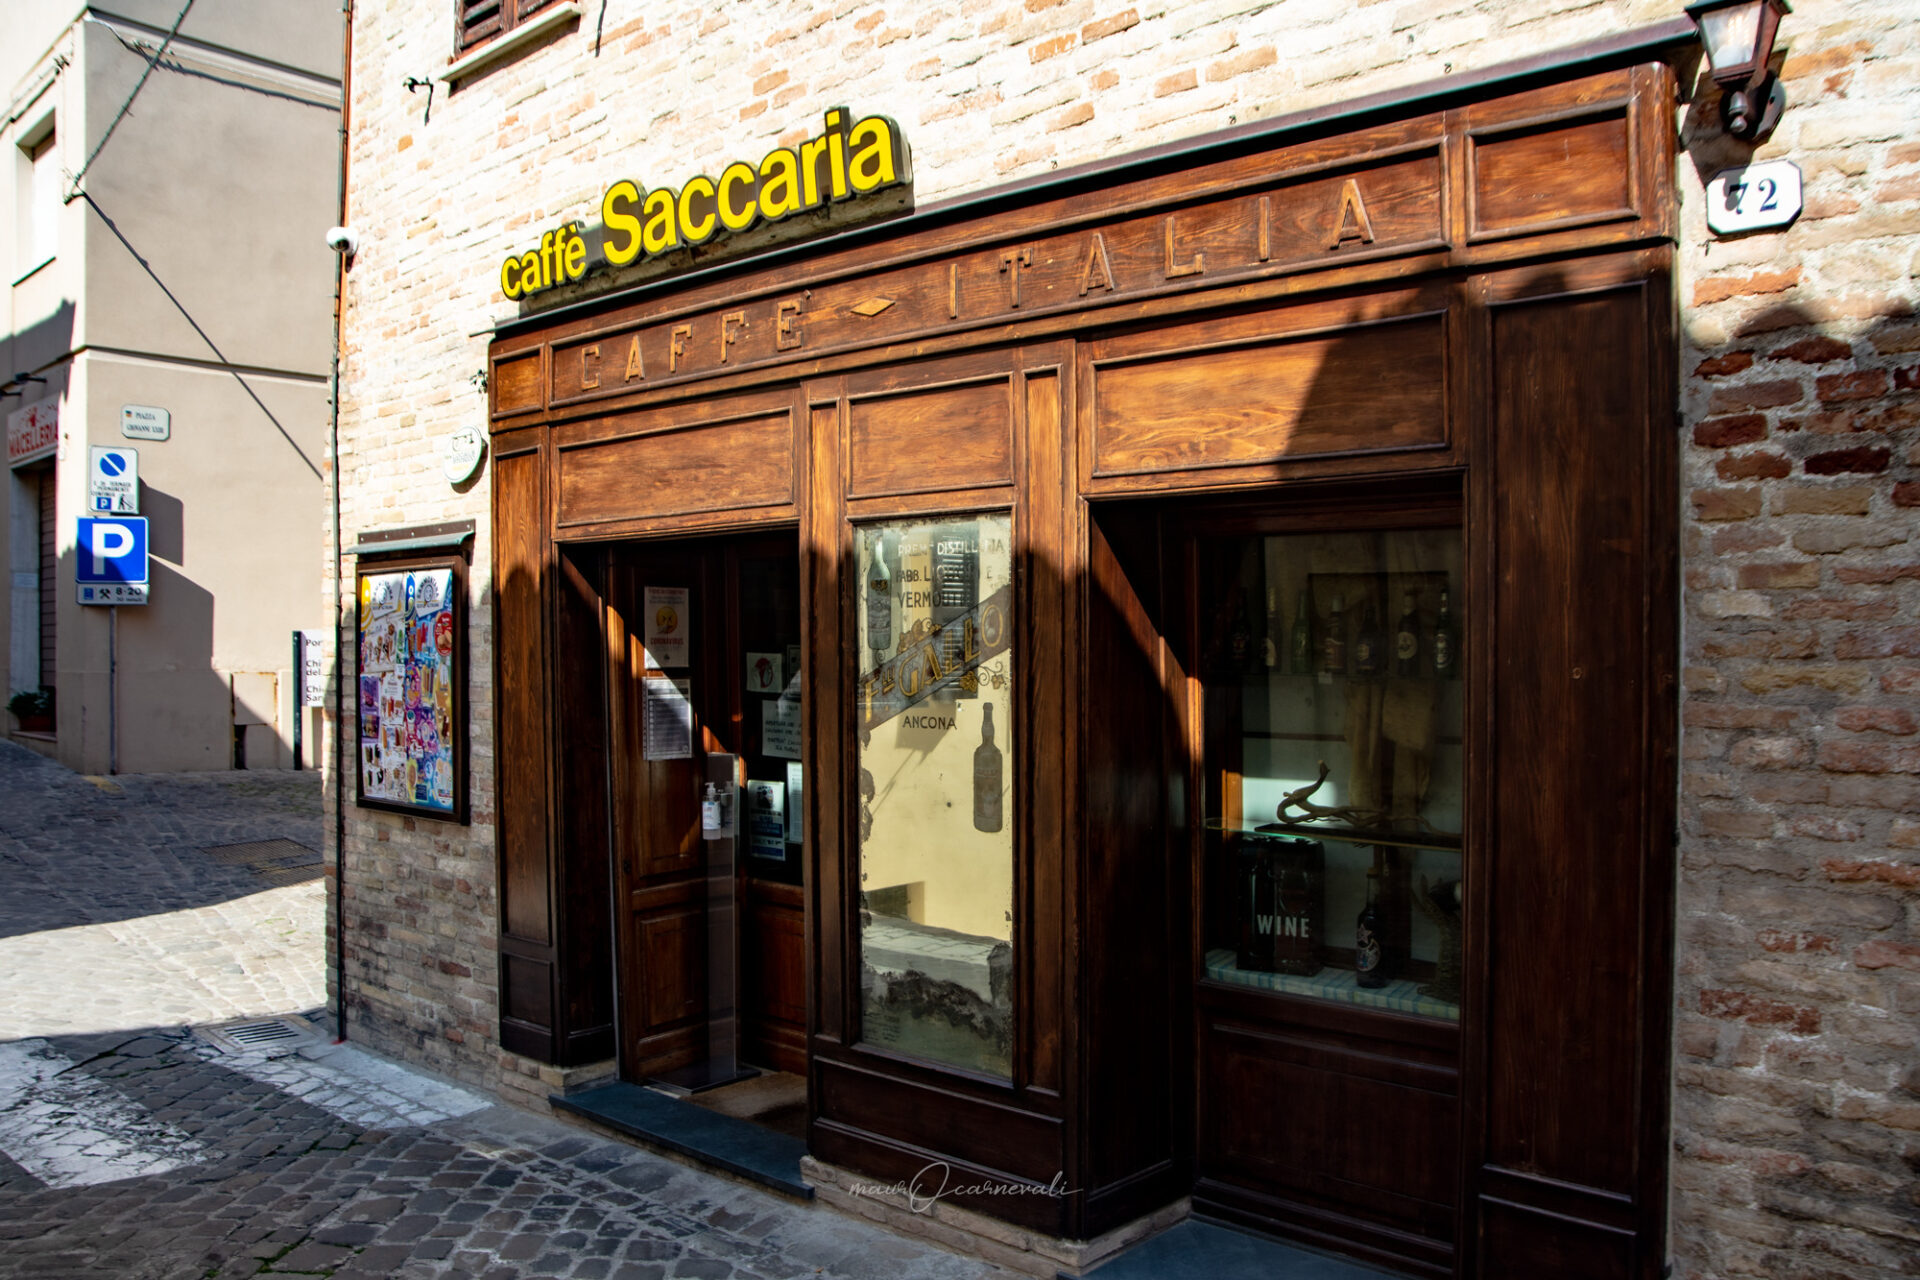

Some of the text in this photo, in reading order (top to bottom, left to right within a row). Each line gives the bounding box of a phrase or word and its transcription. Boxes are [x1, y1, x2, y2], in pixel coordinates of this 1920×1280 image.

[501, 109, 896, 299] caffè Saccaria
[1727, 177, 1778, 215] 72
[949, 178, 1375, 320] ITALIA
[8, 419, 59, 458] MACELLERIA
[100, 498, 108, 508] P
[92, 522, 135, 575] P
[900, 604, 1004, 697] GALLO
[902, 715, 958, 730] ANCONA
[1257, 914, 1310, 938] WINE
